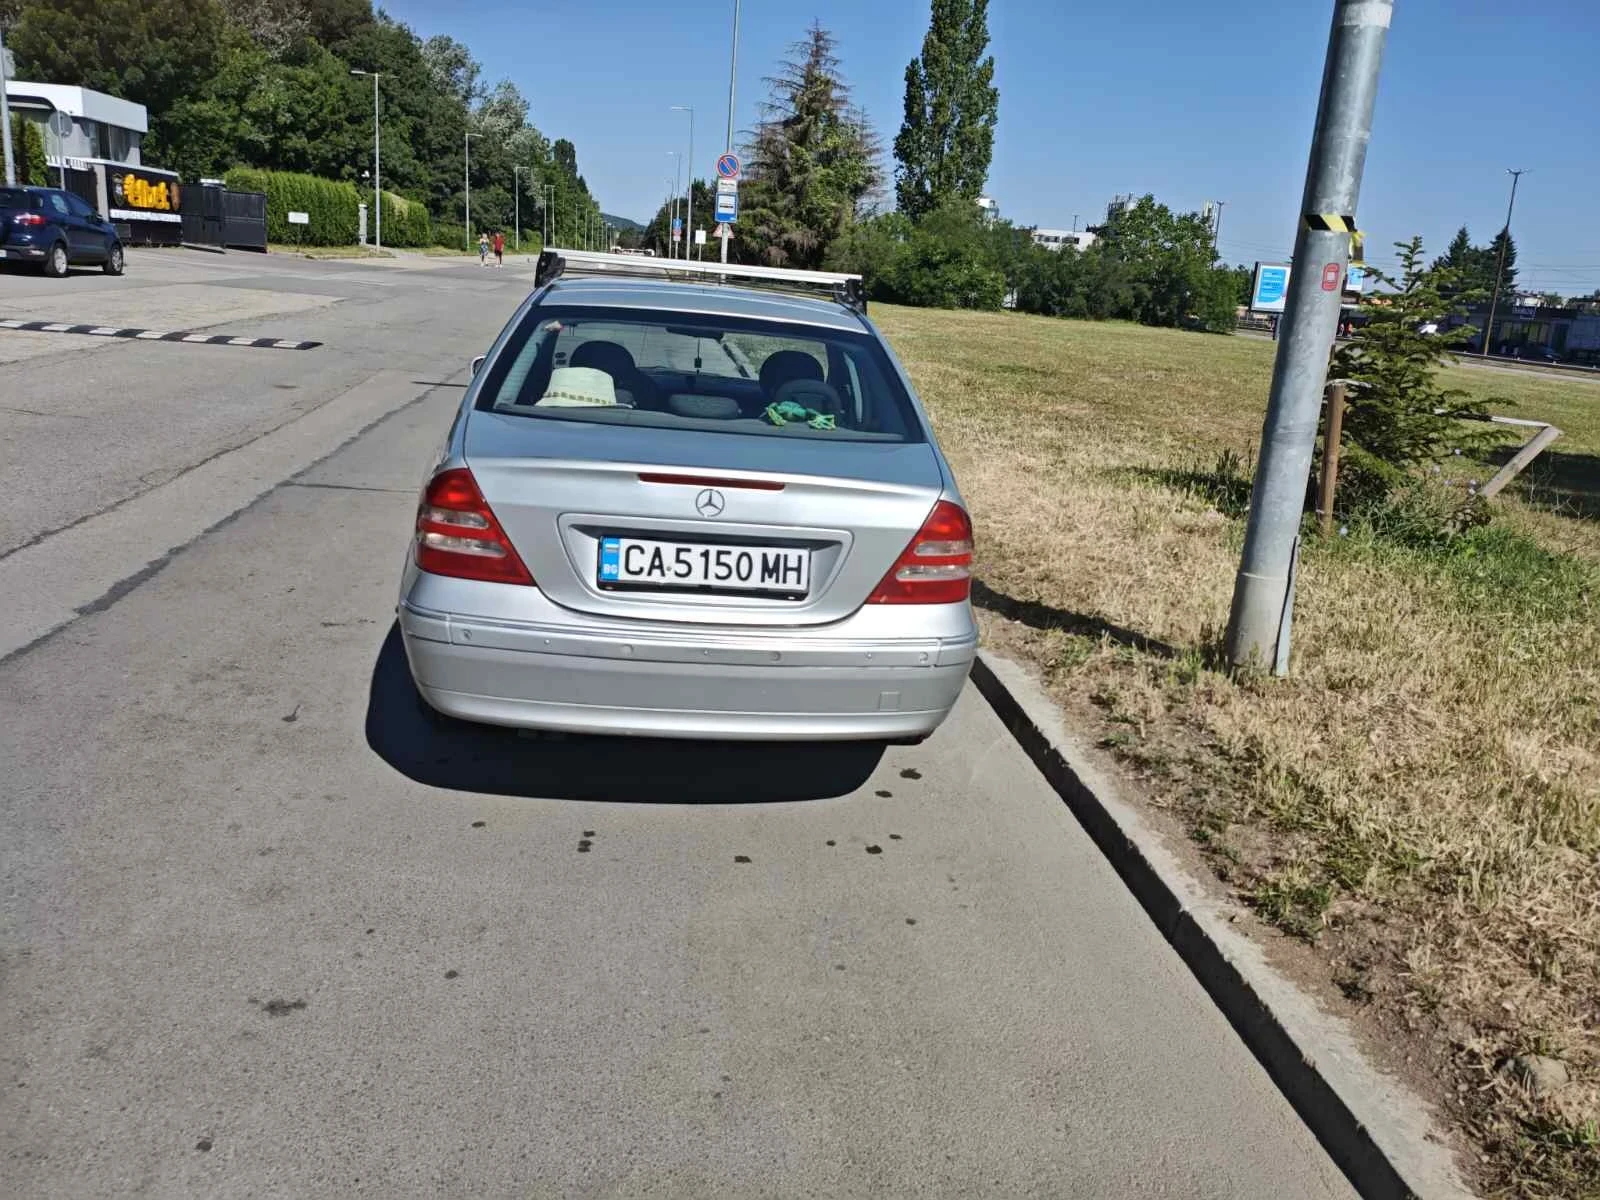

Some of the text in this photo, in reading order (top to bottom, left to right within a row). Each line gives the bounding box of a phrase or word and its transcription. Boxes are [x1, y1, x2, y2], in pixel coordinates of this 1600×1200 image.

[624, 545, 802, 584] CA 5150 MH
